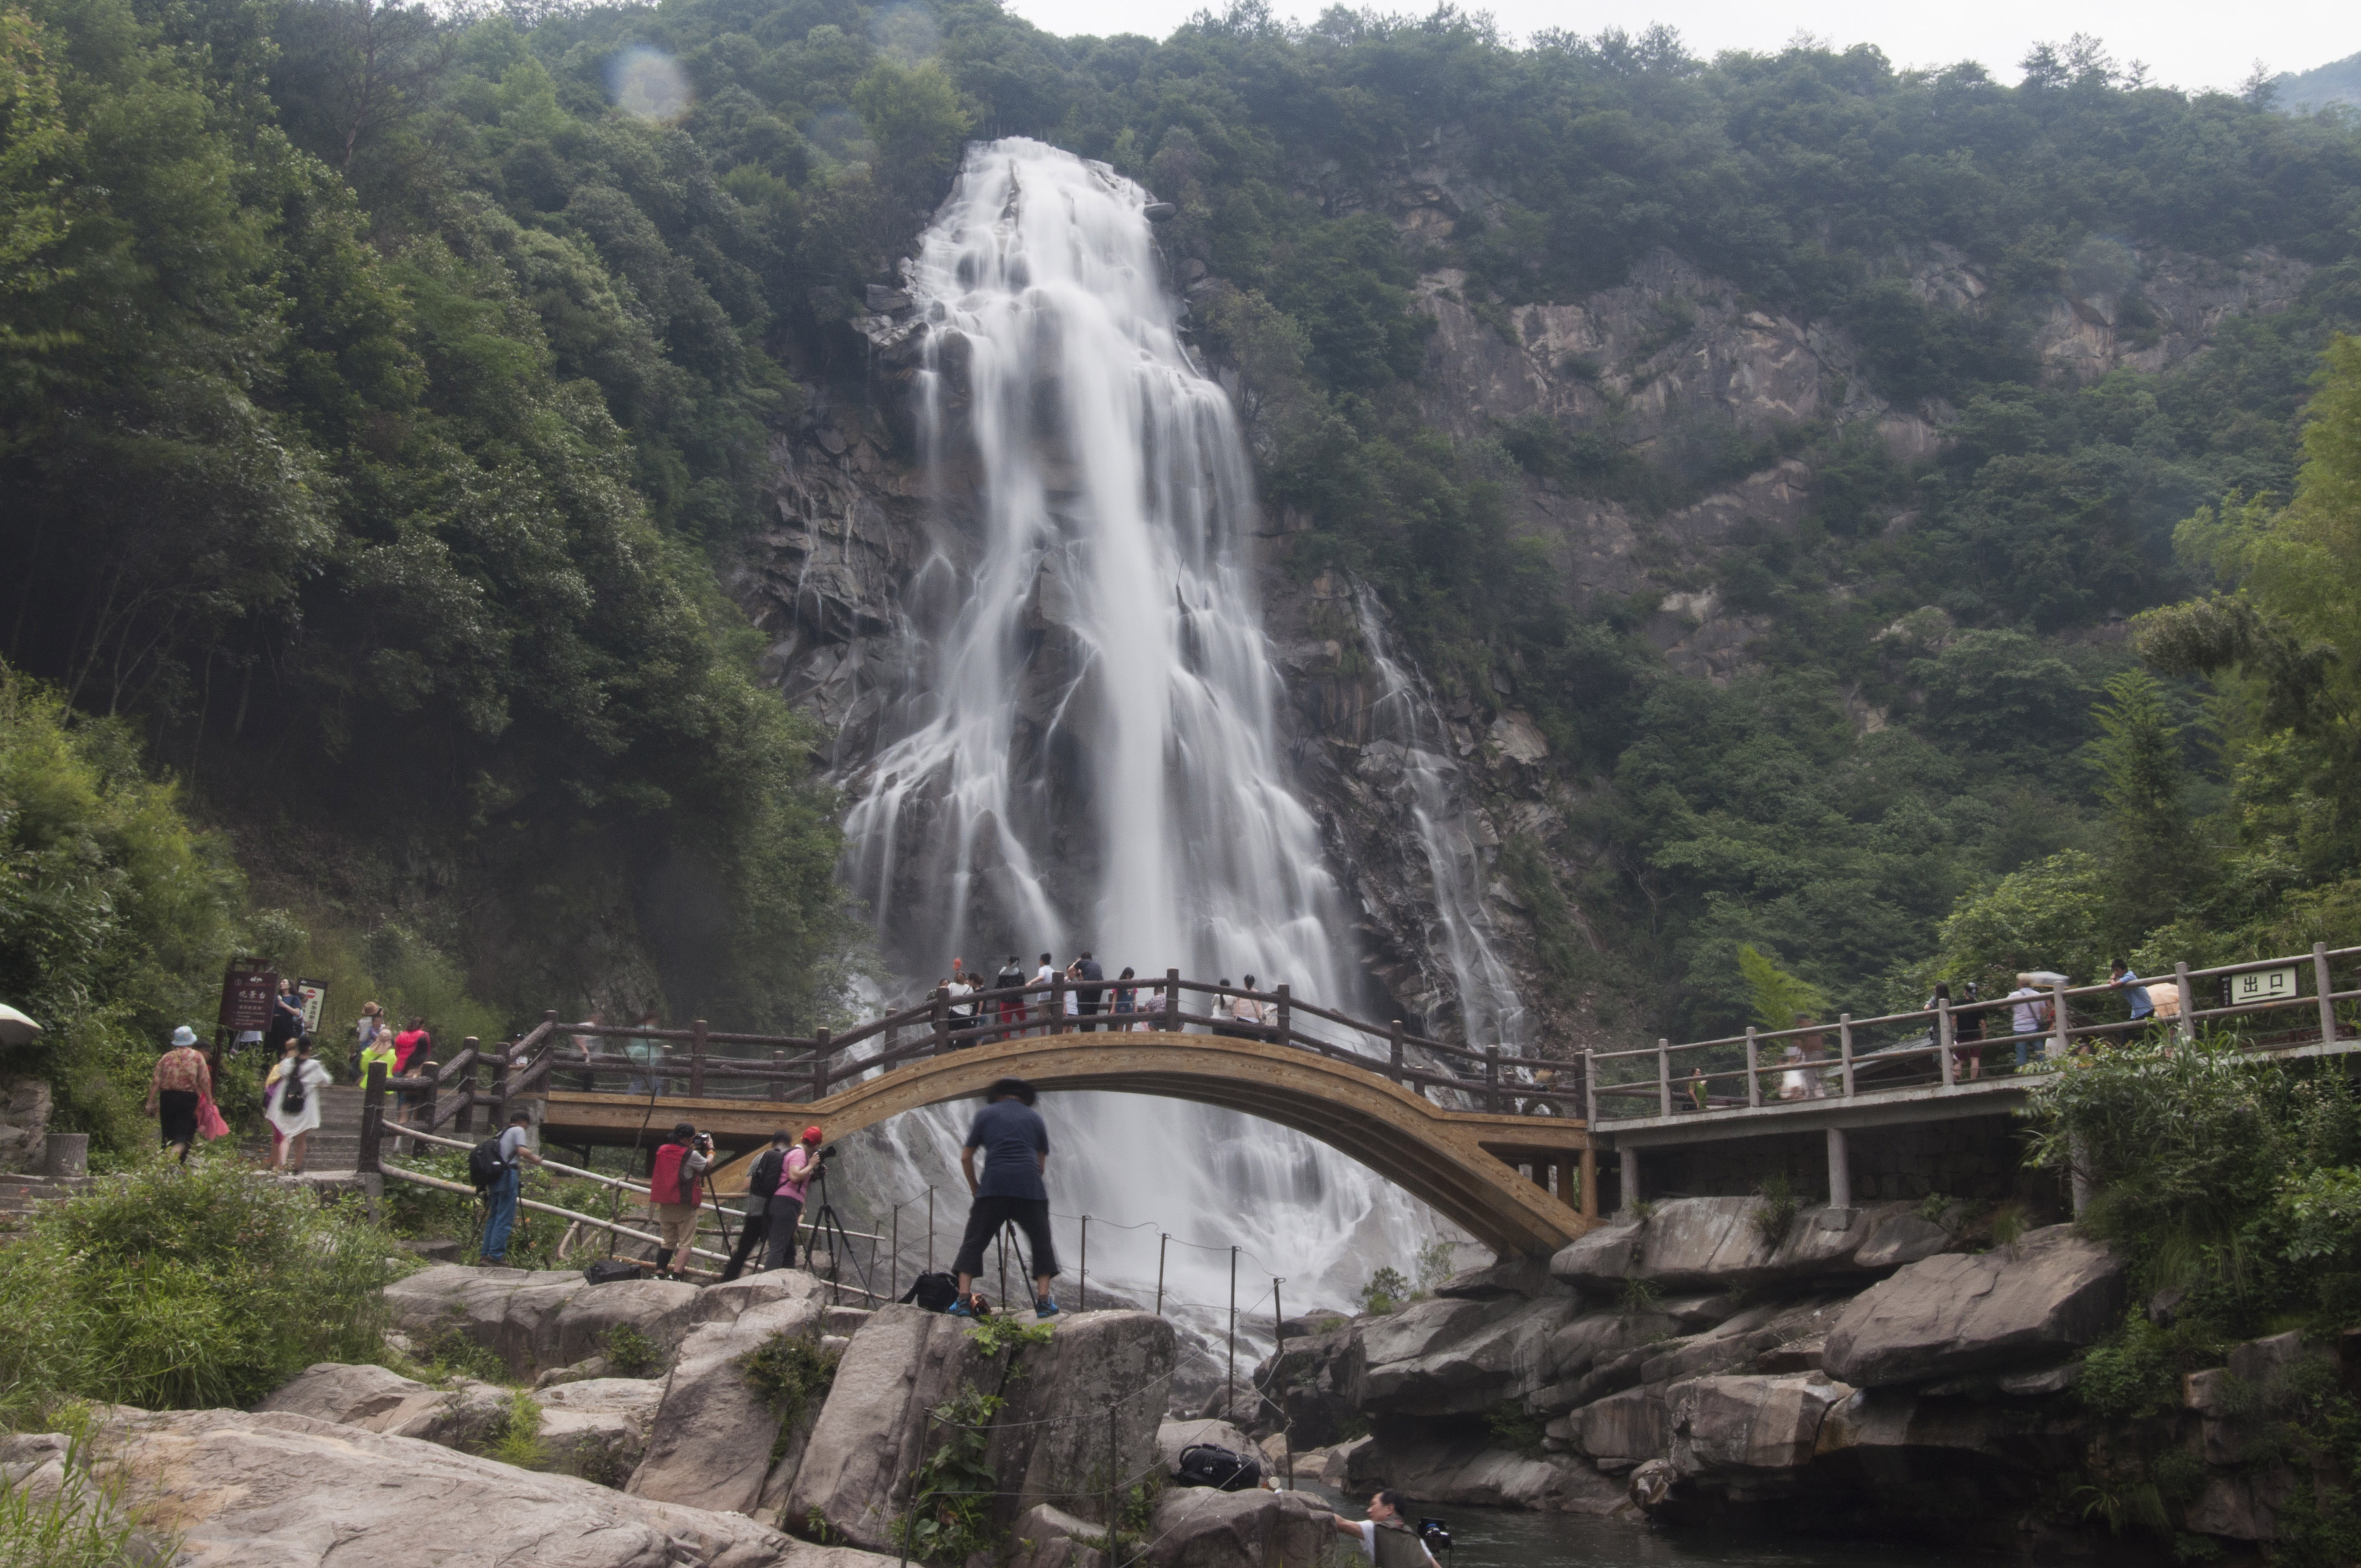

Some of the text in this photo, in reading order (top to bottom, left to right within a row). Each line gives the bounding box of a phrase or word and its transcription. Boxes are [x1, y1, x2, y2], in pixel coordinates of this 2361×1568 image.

[2244, 973, 2282, 993] 出口
[238, 990, 265, 999] 观景台
